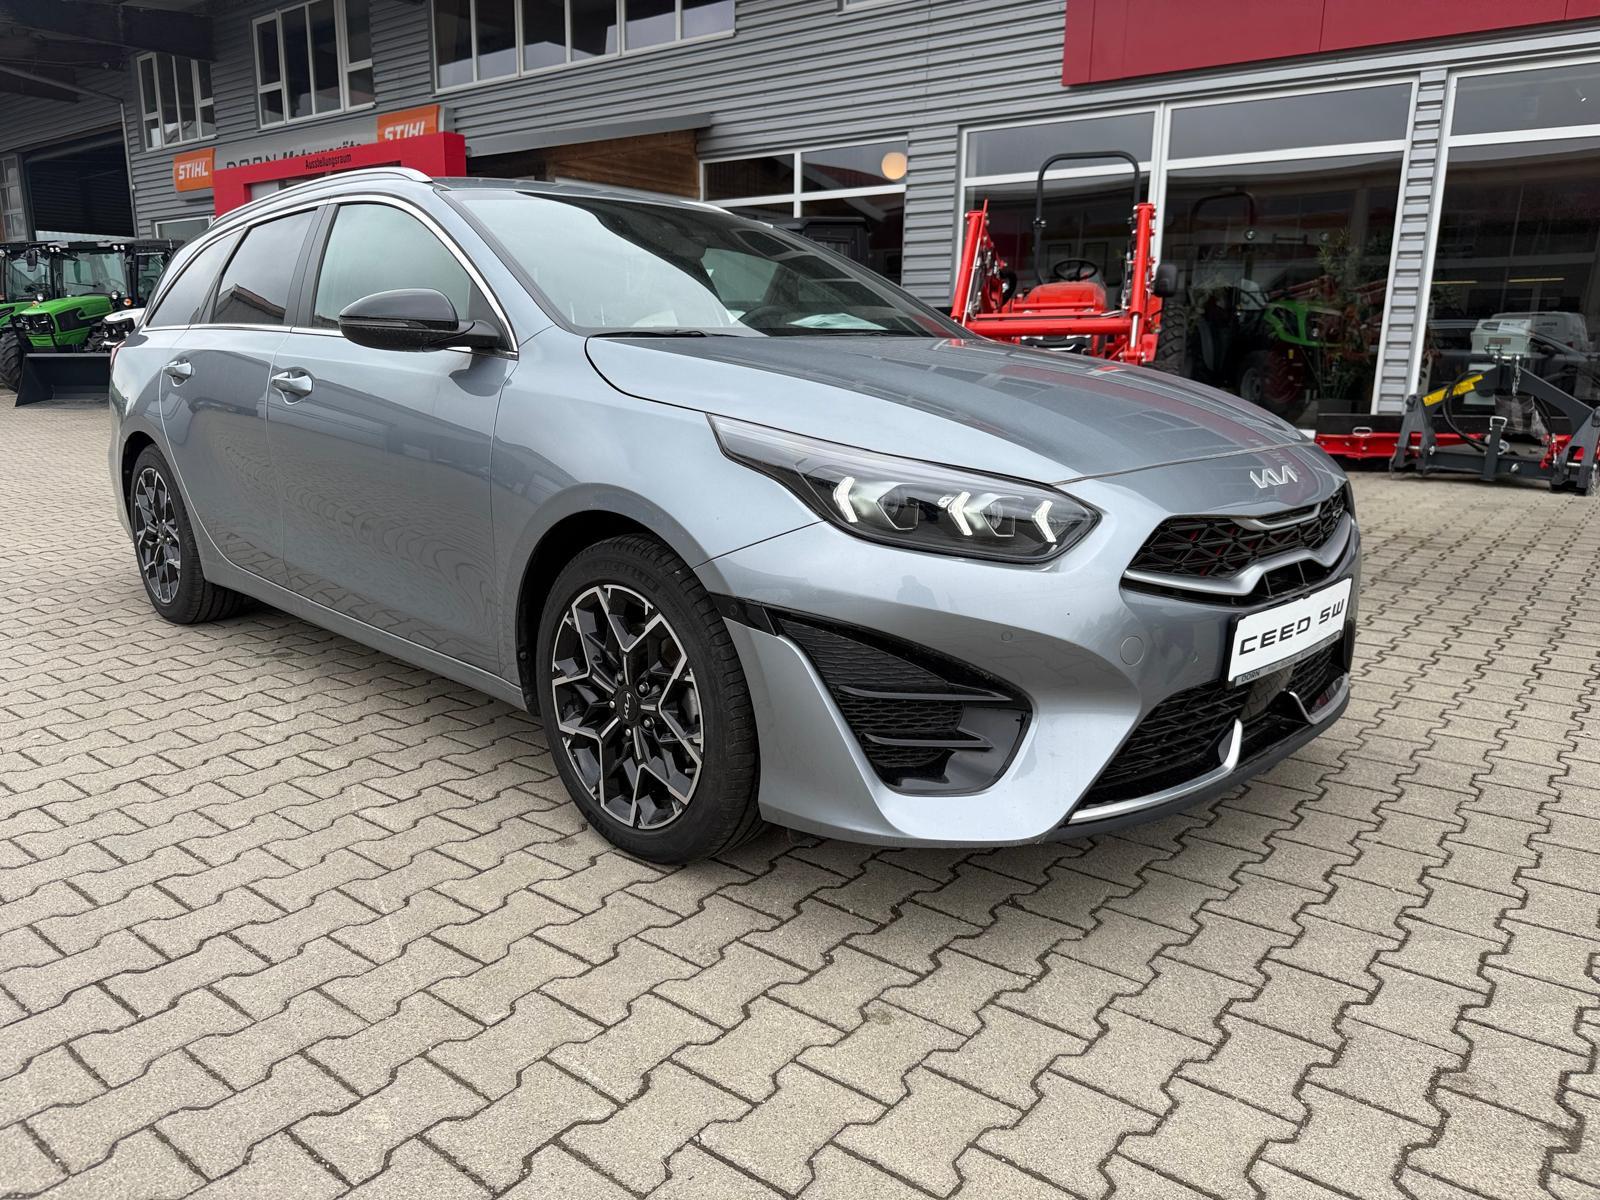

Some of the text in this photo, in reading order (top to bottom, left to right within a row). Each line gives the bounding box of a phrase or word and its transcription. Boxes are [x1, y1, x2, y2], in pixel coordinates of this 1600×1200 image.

[178, 160, 209, 180] STIHL
[305, 153, 352, 170] Ausstellungsraum
[1249, 465, 1298, 489] KIA
[1239, 598, 1345, 657] CEED SW
